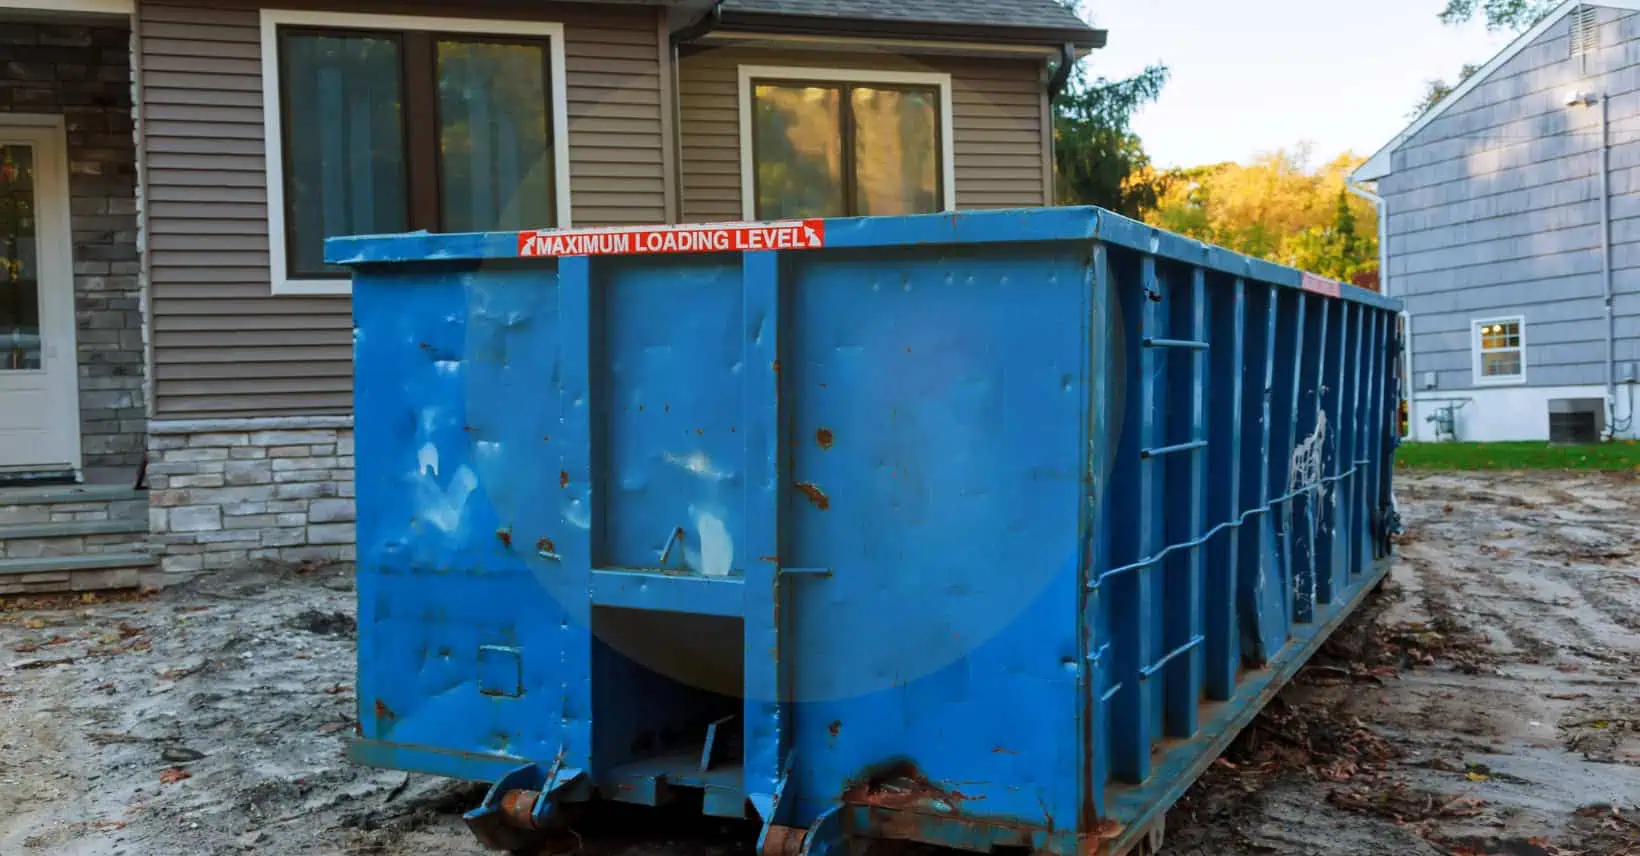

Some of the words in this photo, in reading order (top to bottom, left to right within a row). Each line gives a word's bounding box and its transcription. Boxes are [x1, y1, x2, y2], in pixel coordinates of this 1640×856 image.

[536, 233, 630, 255] MAXIMUM
[635, 230, 729, 252] LOADING
[735, 227, 805, 249] LEVEL
